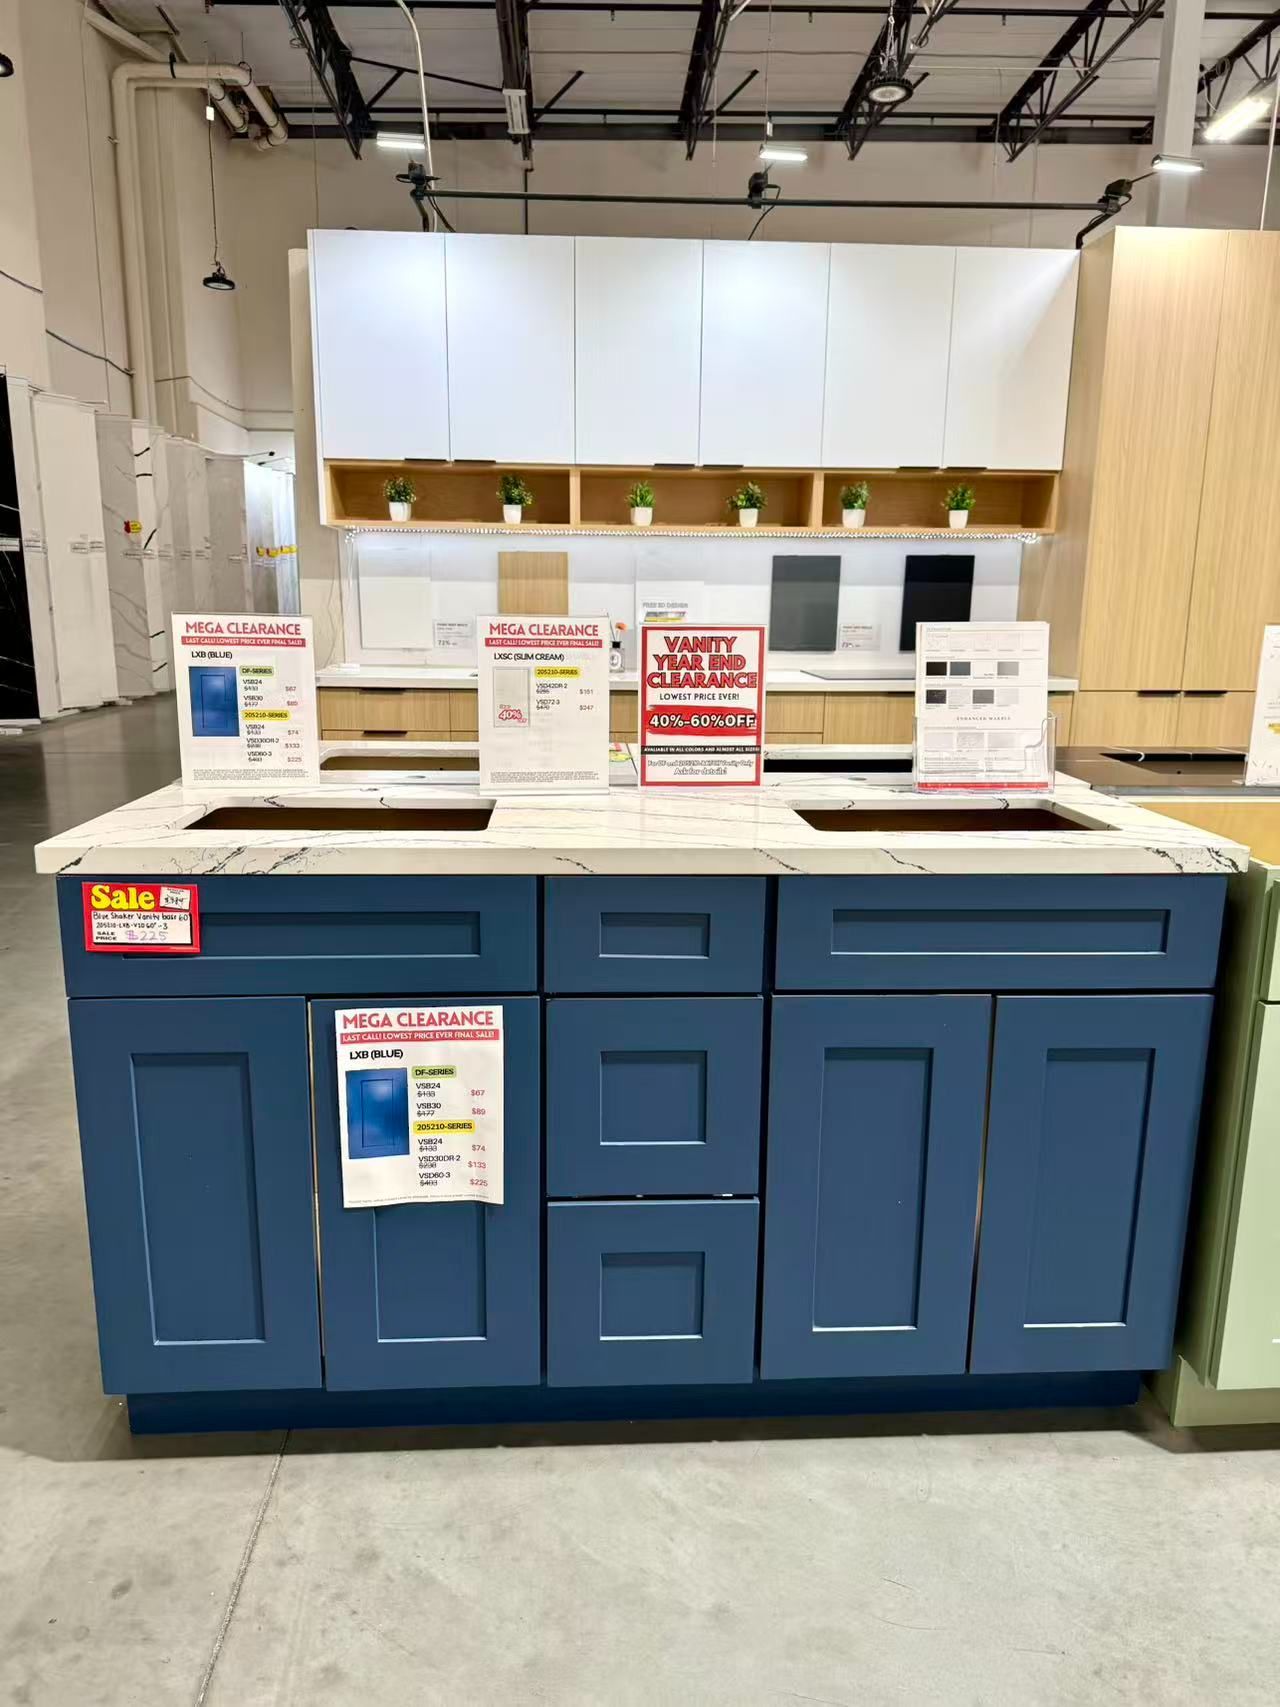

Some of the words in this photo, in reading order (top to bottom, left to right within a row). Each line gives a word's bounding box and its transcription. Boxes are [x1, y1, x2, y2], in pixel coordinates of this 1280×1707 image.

[185, 621, 224, 634] MEGA
[227, 622, 301, 635] CLEARANCE
[489, 623, 526, 635] MEGA
[528, 624, 599, 636] CLEARANCE
[664, 636, 737, 653] VANITY
[207, 651, 233, 659] (BLUE)
[493, 652, 513, 660] LXSC
[514, 653, 533, 661] (SLIM
[535, 653, 565, 661] CREAM)
[653, 654, 705, 671] YEAR
[708, 654, 746, 671] END
[646, 671, 758, 689] CLEARANCE
[660, 693, 691, 701] LOWEST
[499, 709, 522, 720] 40%
[91, 884, 155, 910] Sale
[93, 912, 109, 920] Blue
[111, 912, 134, 920] Shaker
[136, 912, 160, 921] Vanity
[161, 912, 177, 920] base
[125, 930, 169, 941] $225
[343, 1013, 393, 1029] MEGA
[397, 1010, 494, 1028] CLEARANCE
[343, 1035, 361, 1043] LAST
[383, 1032, 412, 1040] LOWEST
[435, 1031, 453, 1039] EVER
[350, 1050, 369, 1060] LXB
[371, 1049, 403, 1060] (BLUE)
[415, 1068, 454, 1076] DF-SERIES
[415, 1082, 441, 1090] VSB24
[471, 1089, 485, 1097] $67
[416, 1102, 442, 1110] VSB30
[472, 1108, 486, 1116] $89
[416, 1123, 473, 1131] 205210-SERIES
[417, 1138, 443, 1146] VSB24
[472, 1144, 485, 1152] $74
[468, 1161, 487, 1169] $133
[470, 1179, 488, 1187] $225
